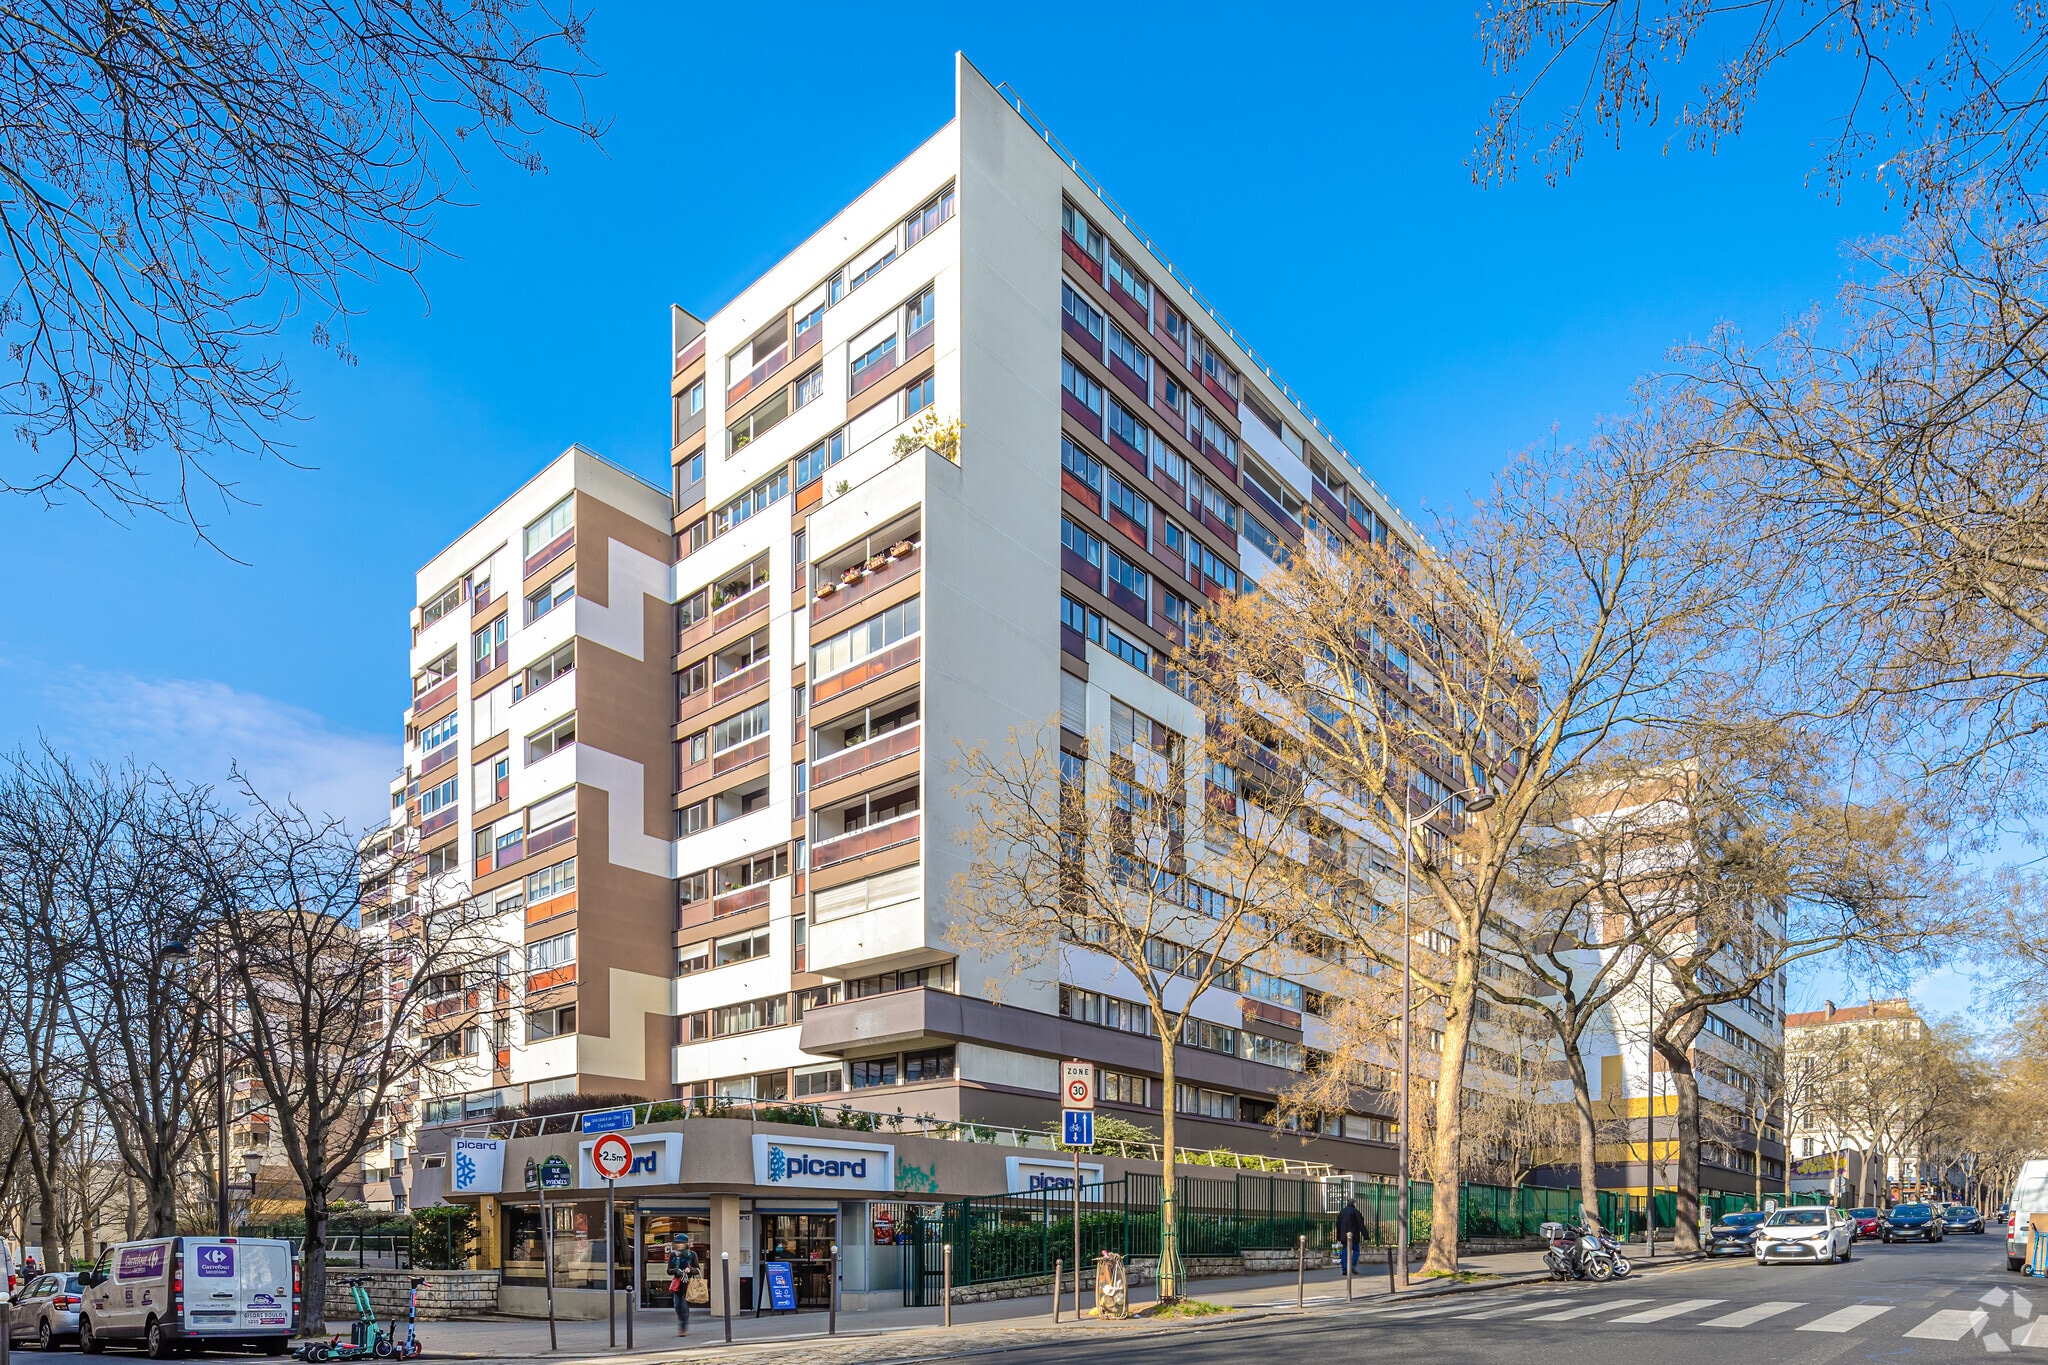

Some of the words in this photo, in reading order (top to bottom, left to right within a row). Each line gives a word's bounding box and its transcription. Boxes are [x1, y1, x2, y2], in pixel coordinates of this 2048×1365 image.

[1073, 1086, 1084, 1096] 30
[457, 1141, 497, 1150] picard
[603, 1151, 623, 1161] 2.5m
[787, 1154, 866, 1179] picard
